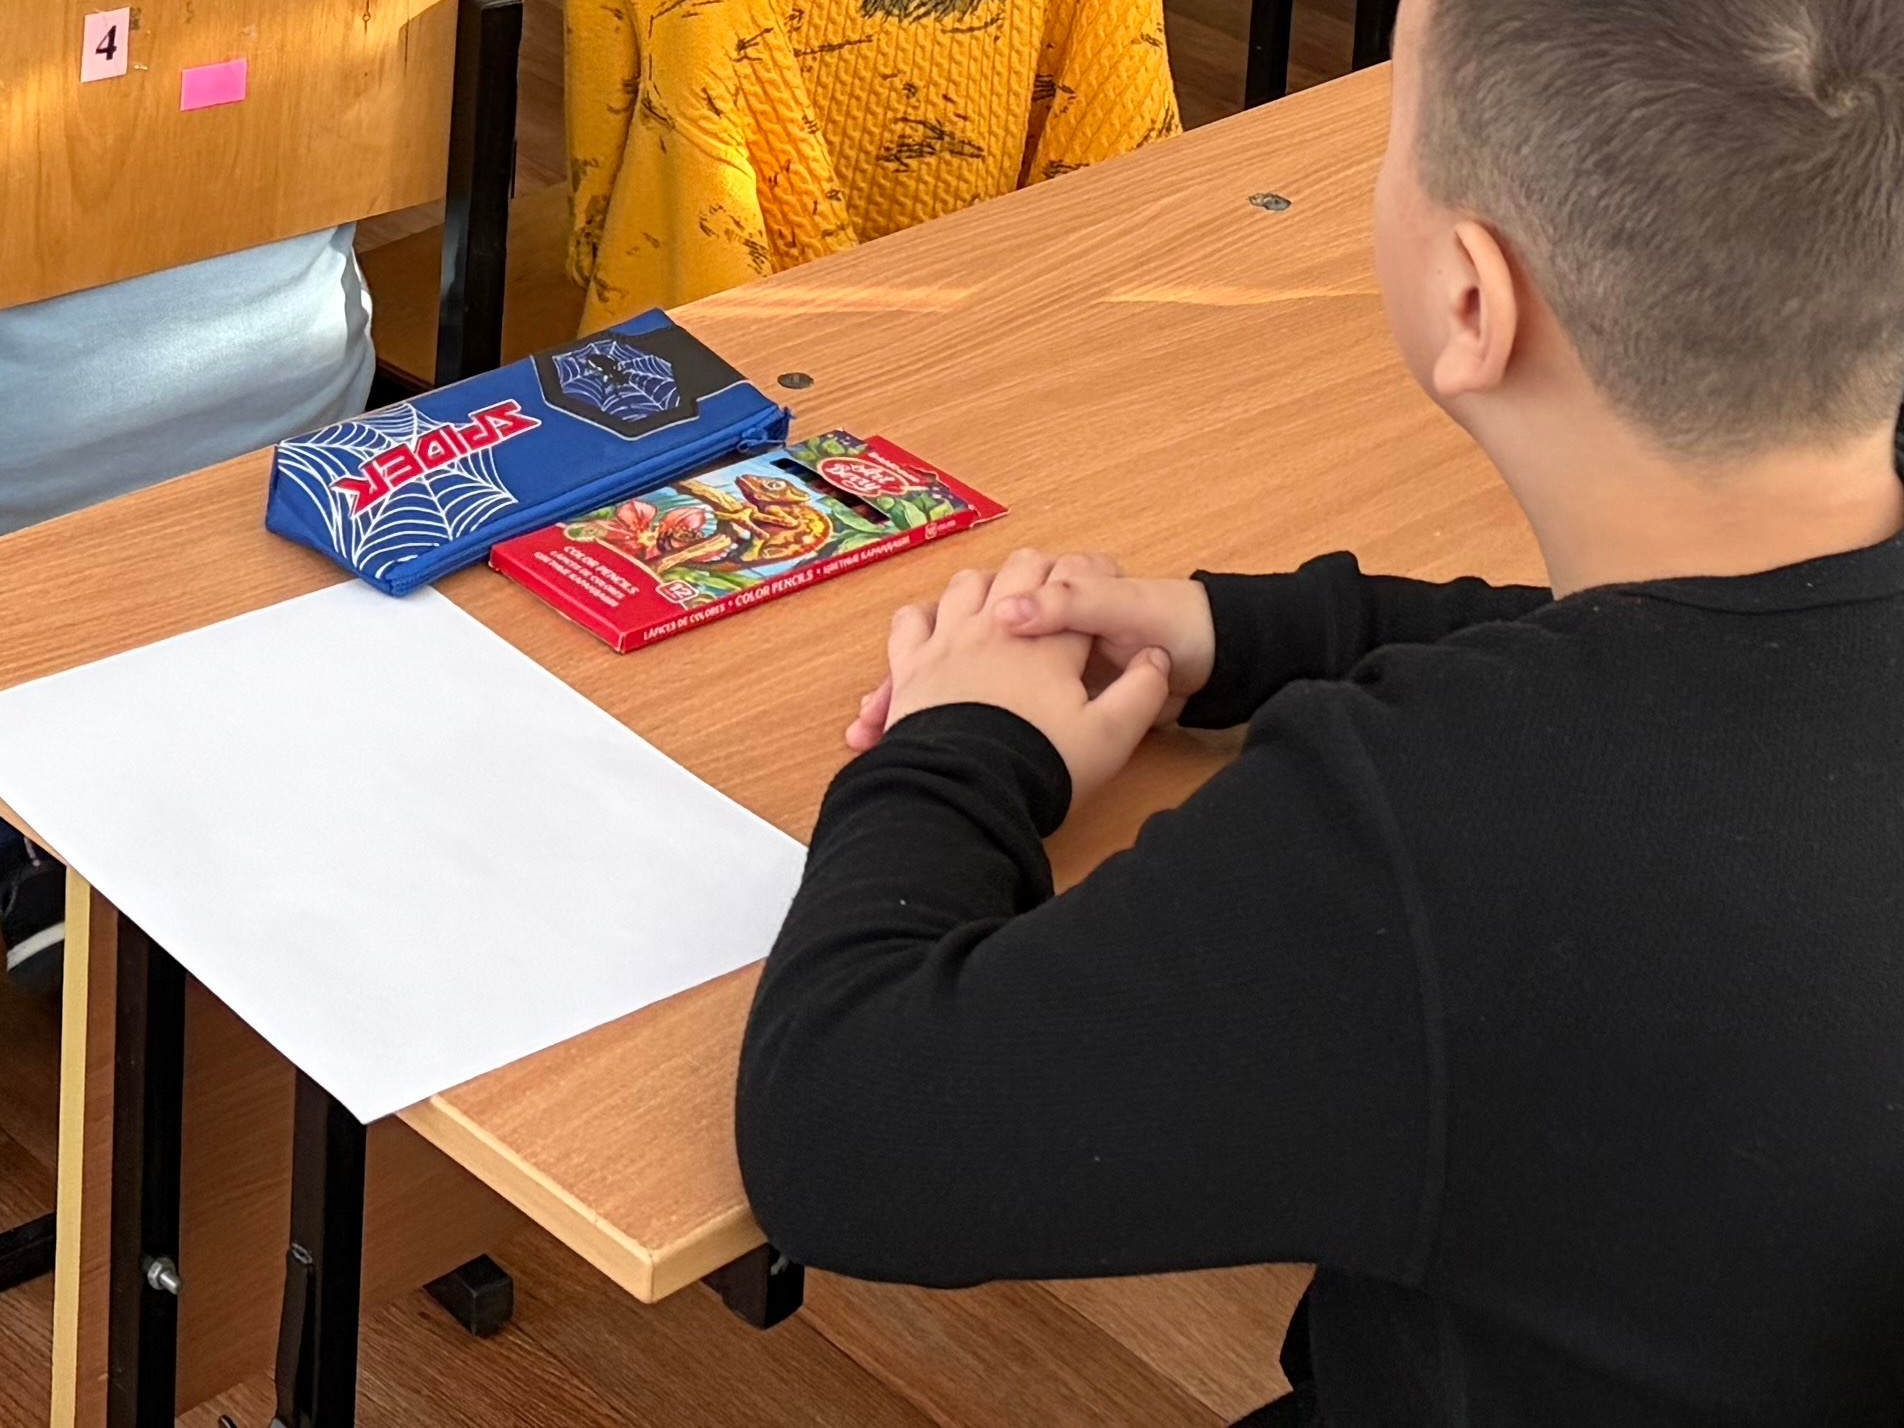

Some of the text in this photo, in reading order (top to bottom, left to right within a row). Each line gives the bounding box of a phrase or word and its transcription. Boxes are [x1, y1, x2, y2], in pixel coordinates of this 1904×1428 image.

[96, 25, 117, 61] 4
[330, 399, 542, 520] SPIDER
[671, 582, 693, 599] 12
[735, 569, 814, 607] COLOR PENCILS
